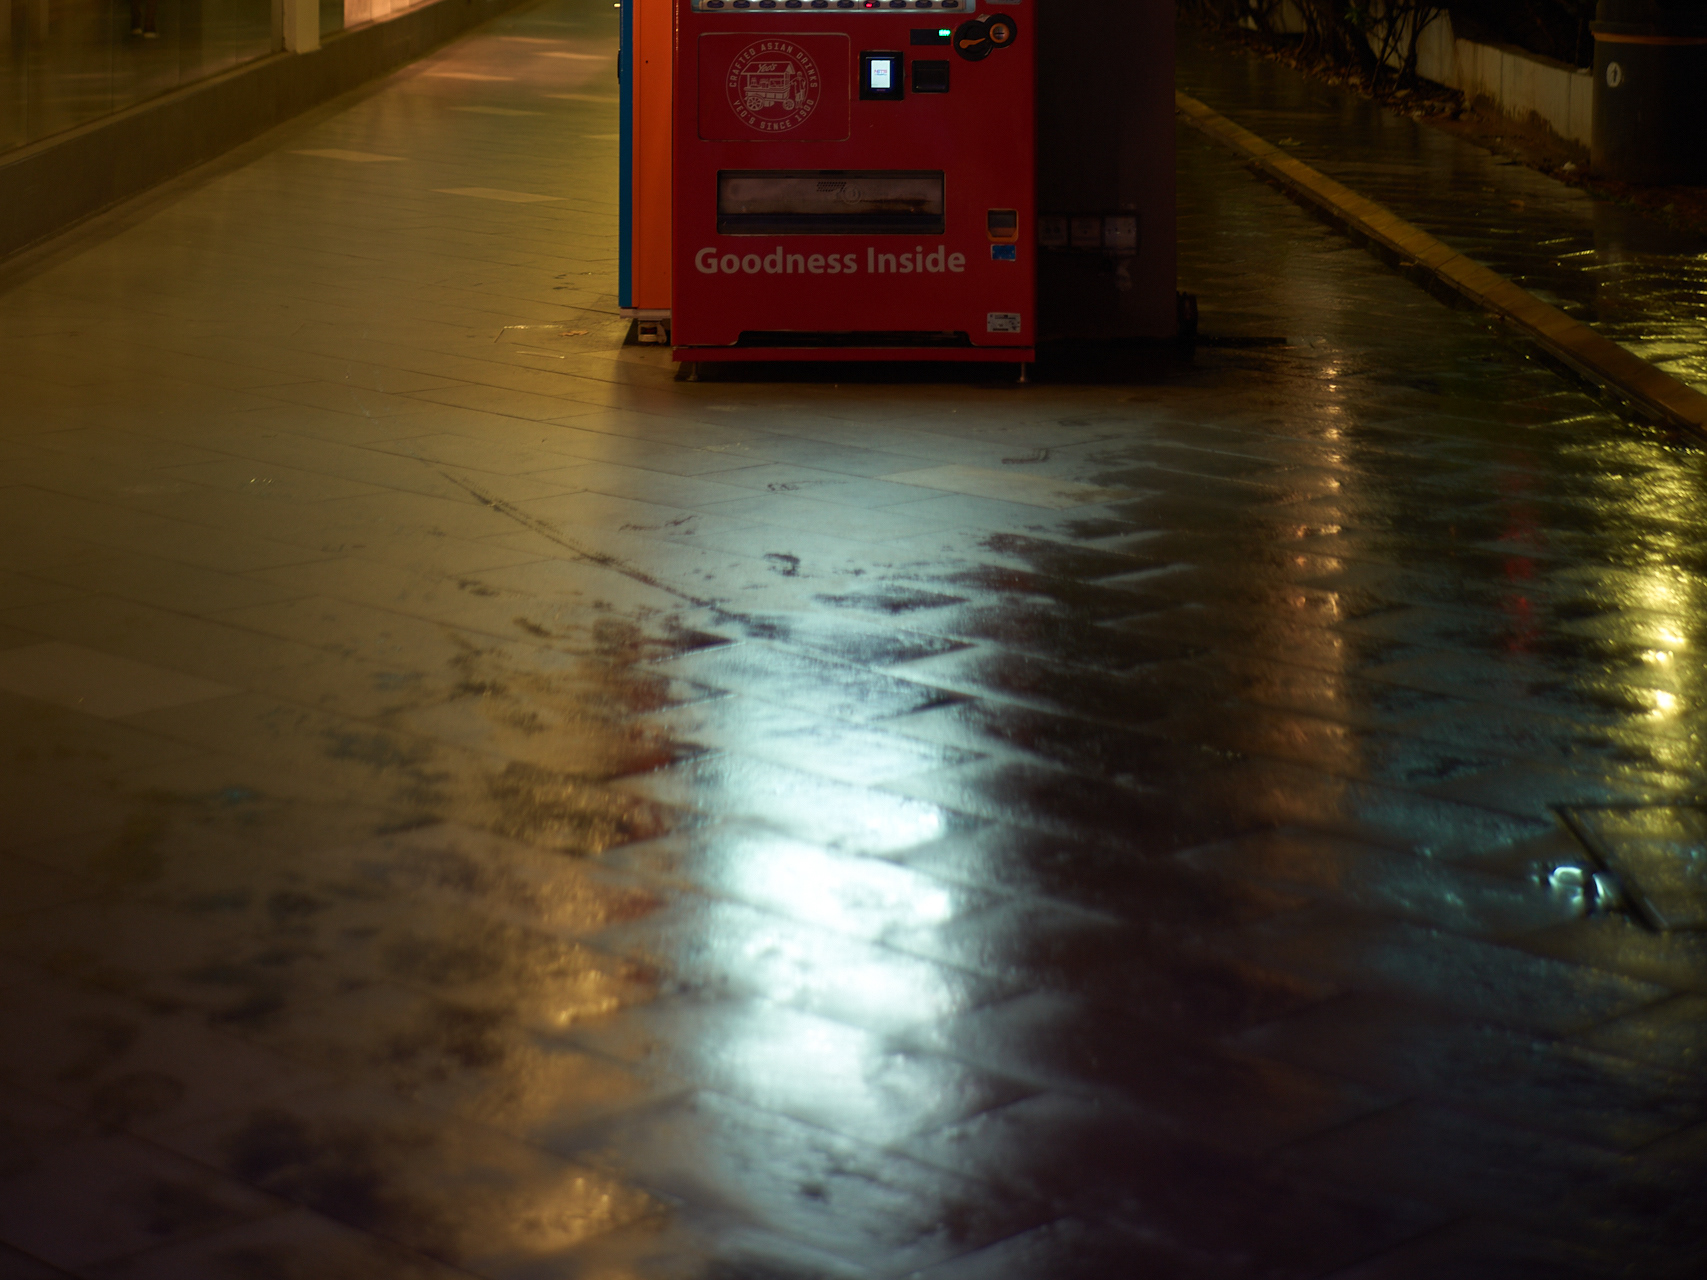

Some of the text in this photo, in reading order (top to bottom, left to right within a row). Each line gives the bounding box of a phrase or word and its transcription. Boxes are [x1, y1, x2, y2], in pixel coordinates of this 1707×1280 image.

[729, 42, 818, 88] CRAFTED ASIAN DRINKS
[757, 63, 778, 74] Yeo's
[733, 99, 814, 130] YEO'S SINCE 1900
[694, 246, 858, 274] Goodness
[867, 245, 966, 274] Inside
